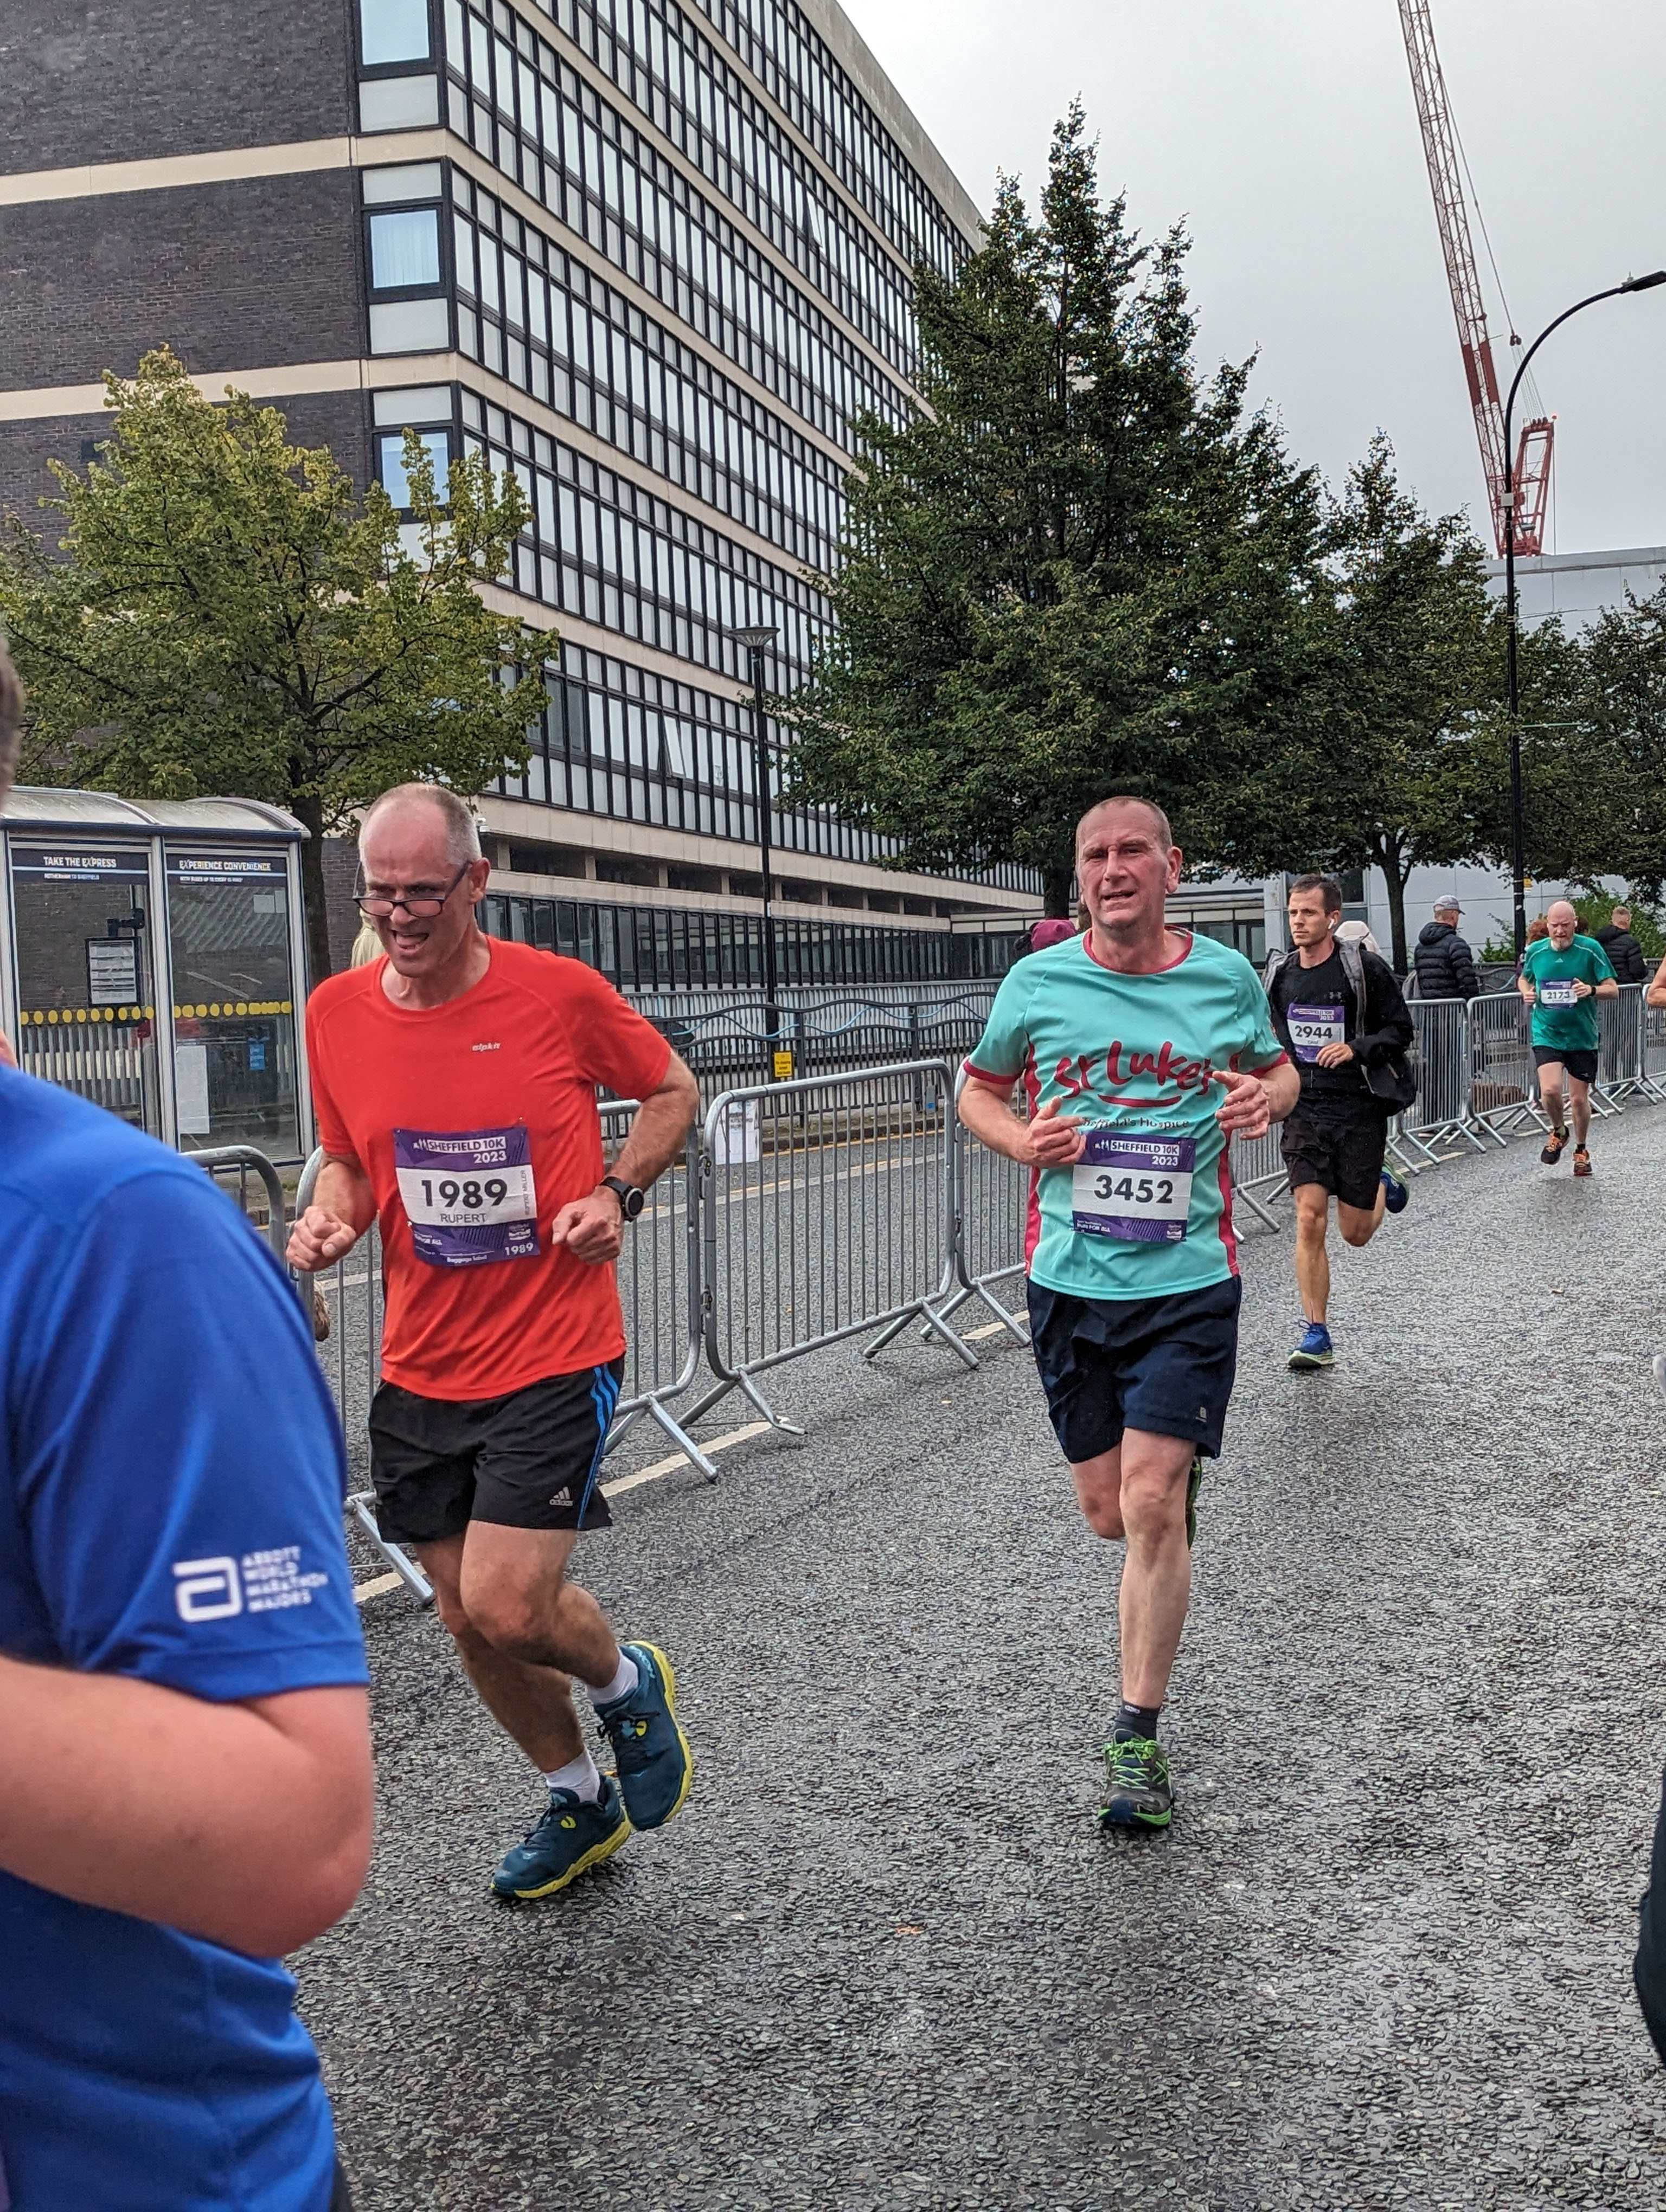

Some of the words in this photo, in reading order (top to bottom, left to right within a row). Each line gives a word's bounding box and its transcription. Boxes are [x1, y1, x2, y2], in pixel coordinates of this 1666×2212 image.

[43, 856, 64, 866] TAKE
[65, 857, 80, 866] THE
[82, 857, 117, 867] EXPRESS
[179, 860, 223, 870] EXPERIENCE
[223, 861, 272, 871] CONVENIENCE
[1547, 991, 1570, 999] 2173
[1295, 1025, 1333, 1039] 2944
[429, 1141, 481, 1152] SHEFFIELD
[483, 1138, 504, 1149] 10K
[1112, 1141, 1161, 1154] SHEFFIELD
[1163, 1145, 1178, 1154] 10K
[473, 1150, 507, 1164] 2023
[1151, 1155, 1178, 1166] 2023
[421, 1178, 508, 1209] 1989
[1094, 1174, 1174, 1204] 3452
[440, 1213, 486, 1223] RUPERT
[504, 1242, 534, 1257] 1989
